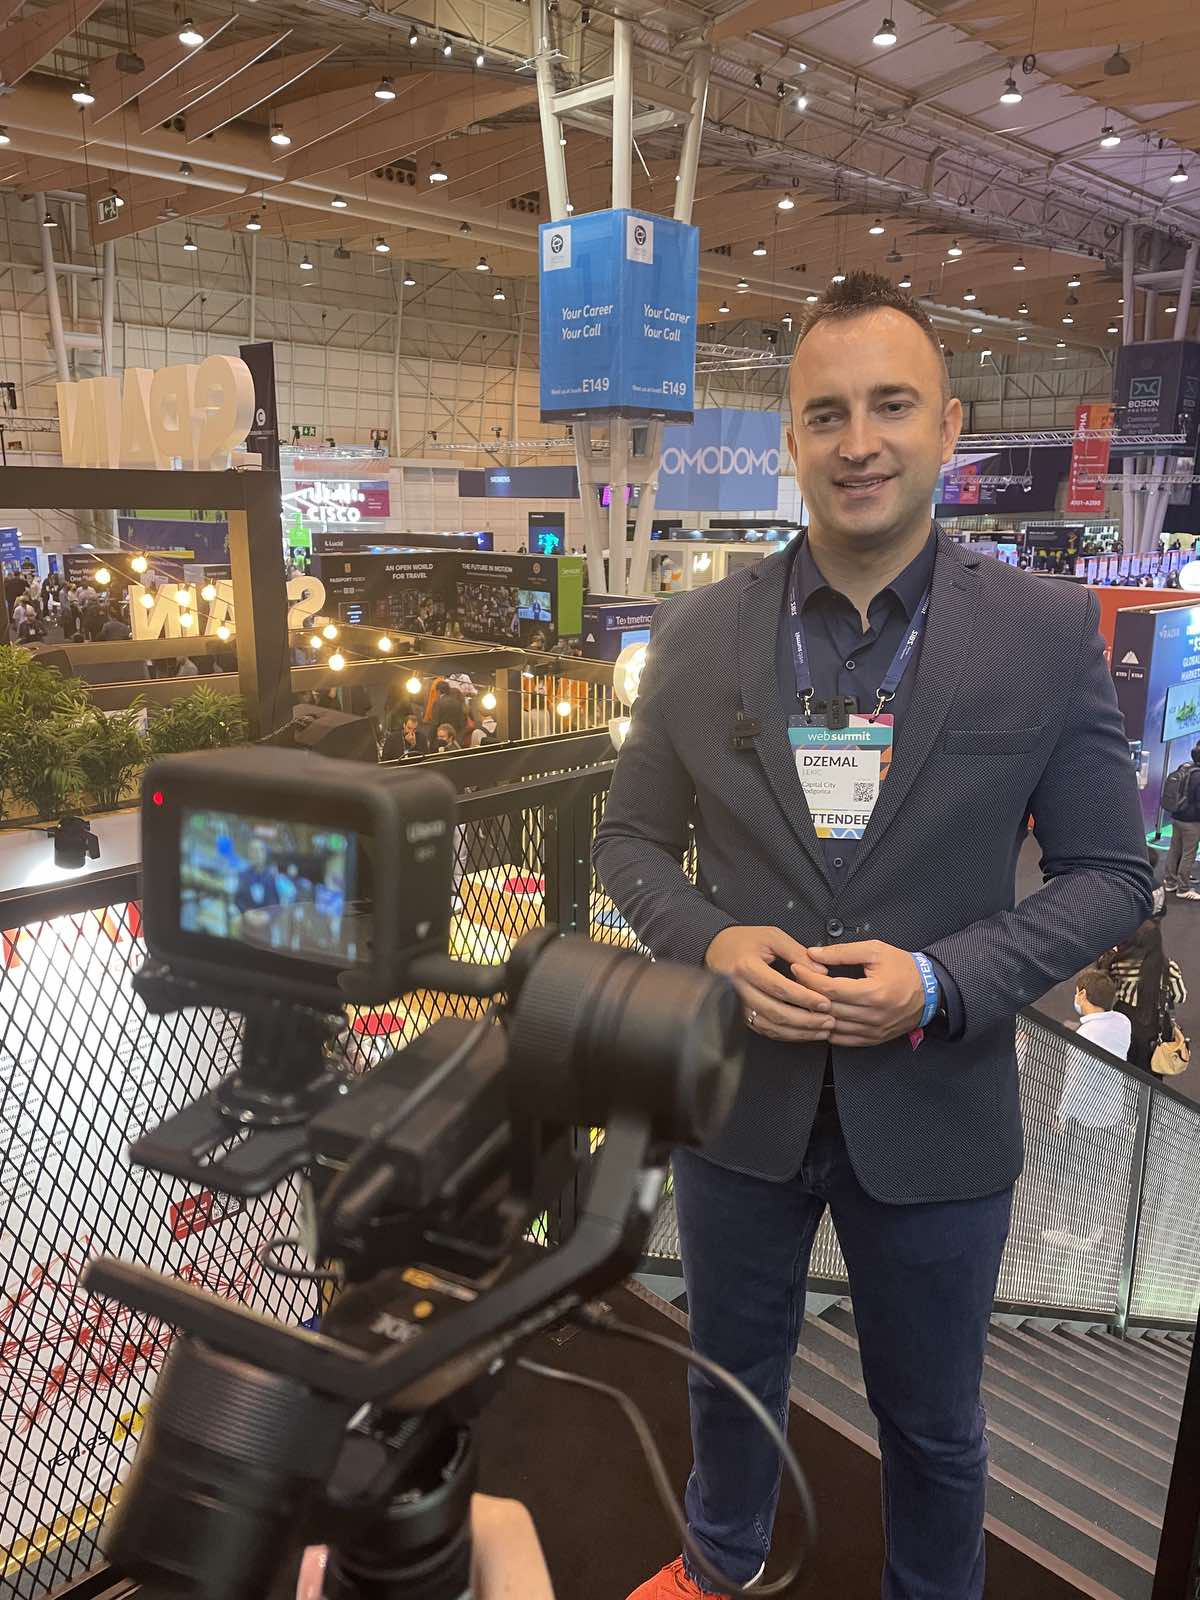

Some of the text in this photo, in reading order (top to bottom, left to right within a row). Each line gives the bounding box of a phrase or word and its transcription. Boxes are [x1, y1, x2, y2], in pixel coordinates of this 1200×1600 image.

[562, 304, 614, 320] Your Career
[643, 303, 690, 324] Your Career
[562, 323, 601, 340] Your Call
[643, 324, 681, 342] Your Call
[582, 377, 610, 392] E149
[662, 381, 687, 396] E149
[1128, 400, 1160, 408] BOSON
[803, 755, 858, 768] DZEMAL
